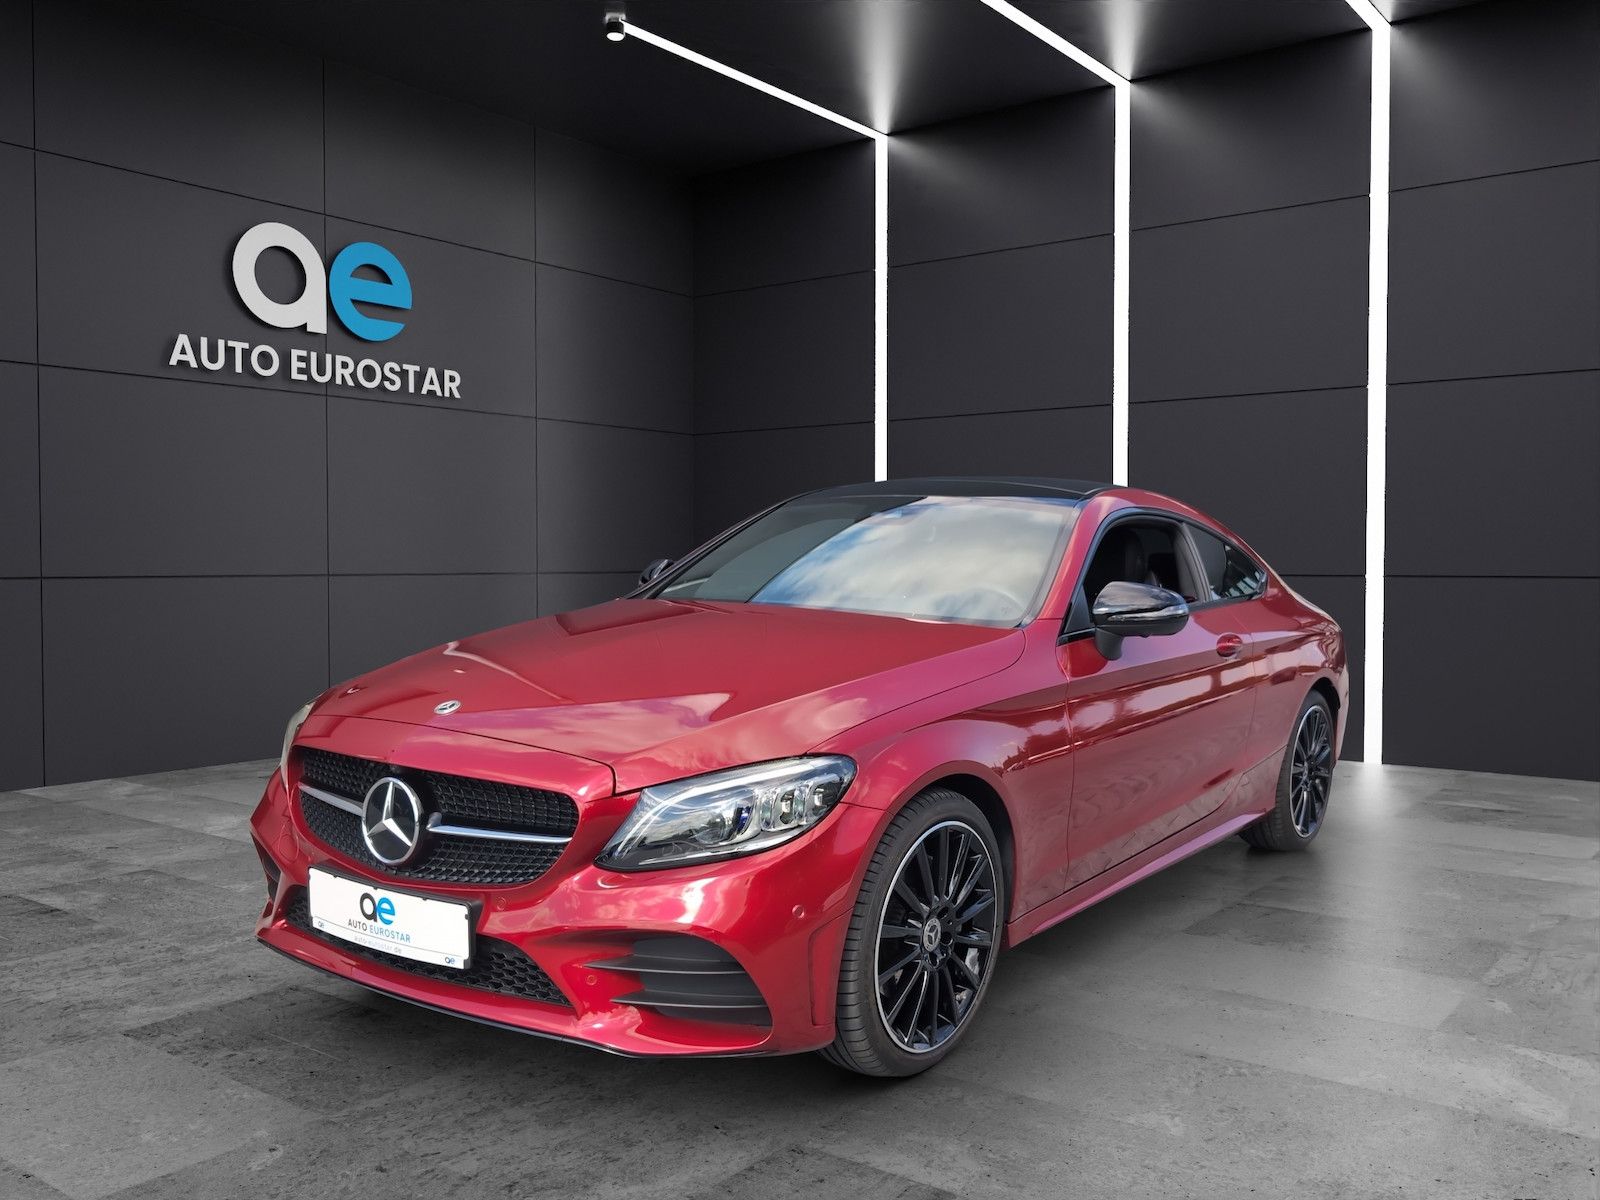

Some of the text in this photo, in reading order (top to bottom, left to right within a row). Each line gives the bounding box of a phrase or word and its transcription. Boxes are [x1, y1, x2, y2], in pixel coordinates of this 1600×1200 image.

[232, 222, 413, 342] ae
[168, 333, 461, 399] AUTO EUROSTAR
[347, 918, 411, 943] AUTO EUROSTAR
[359, 892, 396, 925] ae
